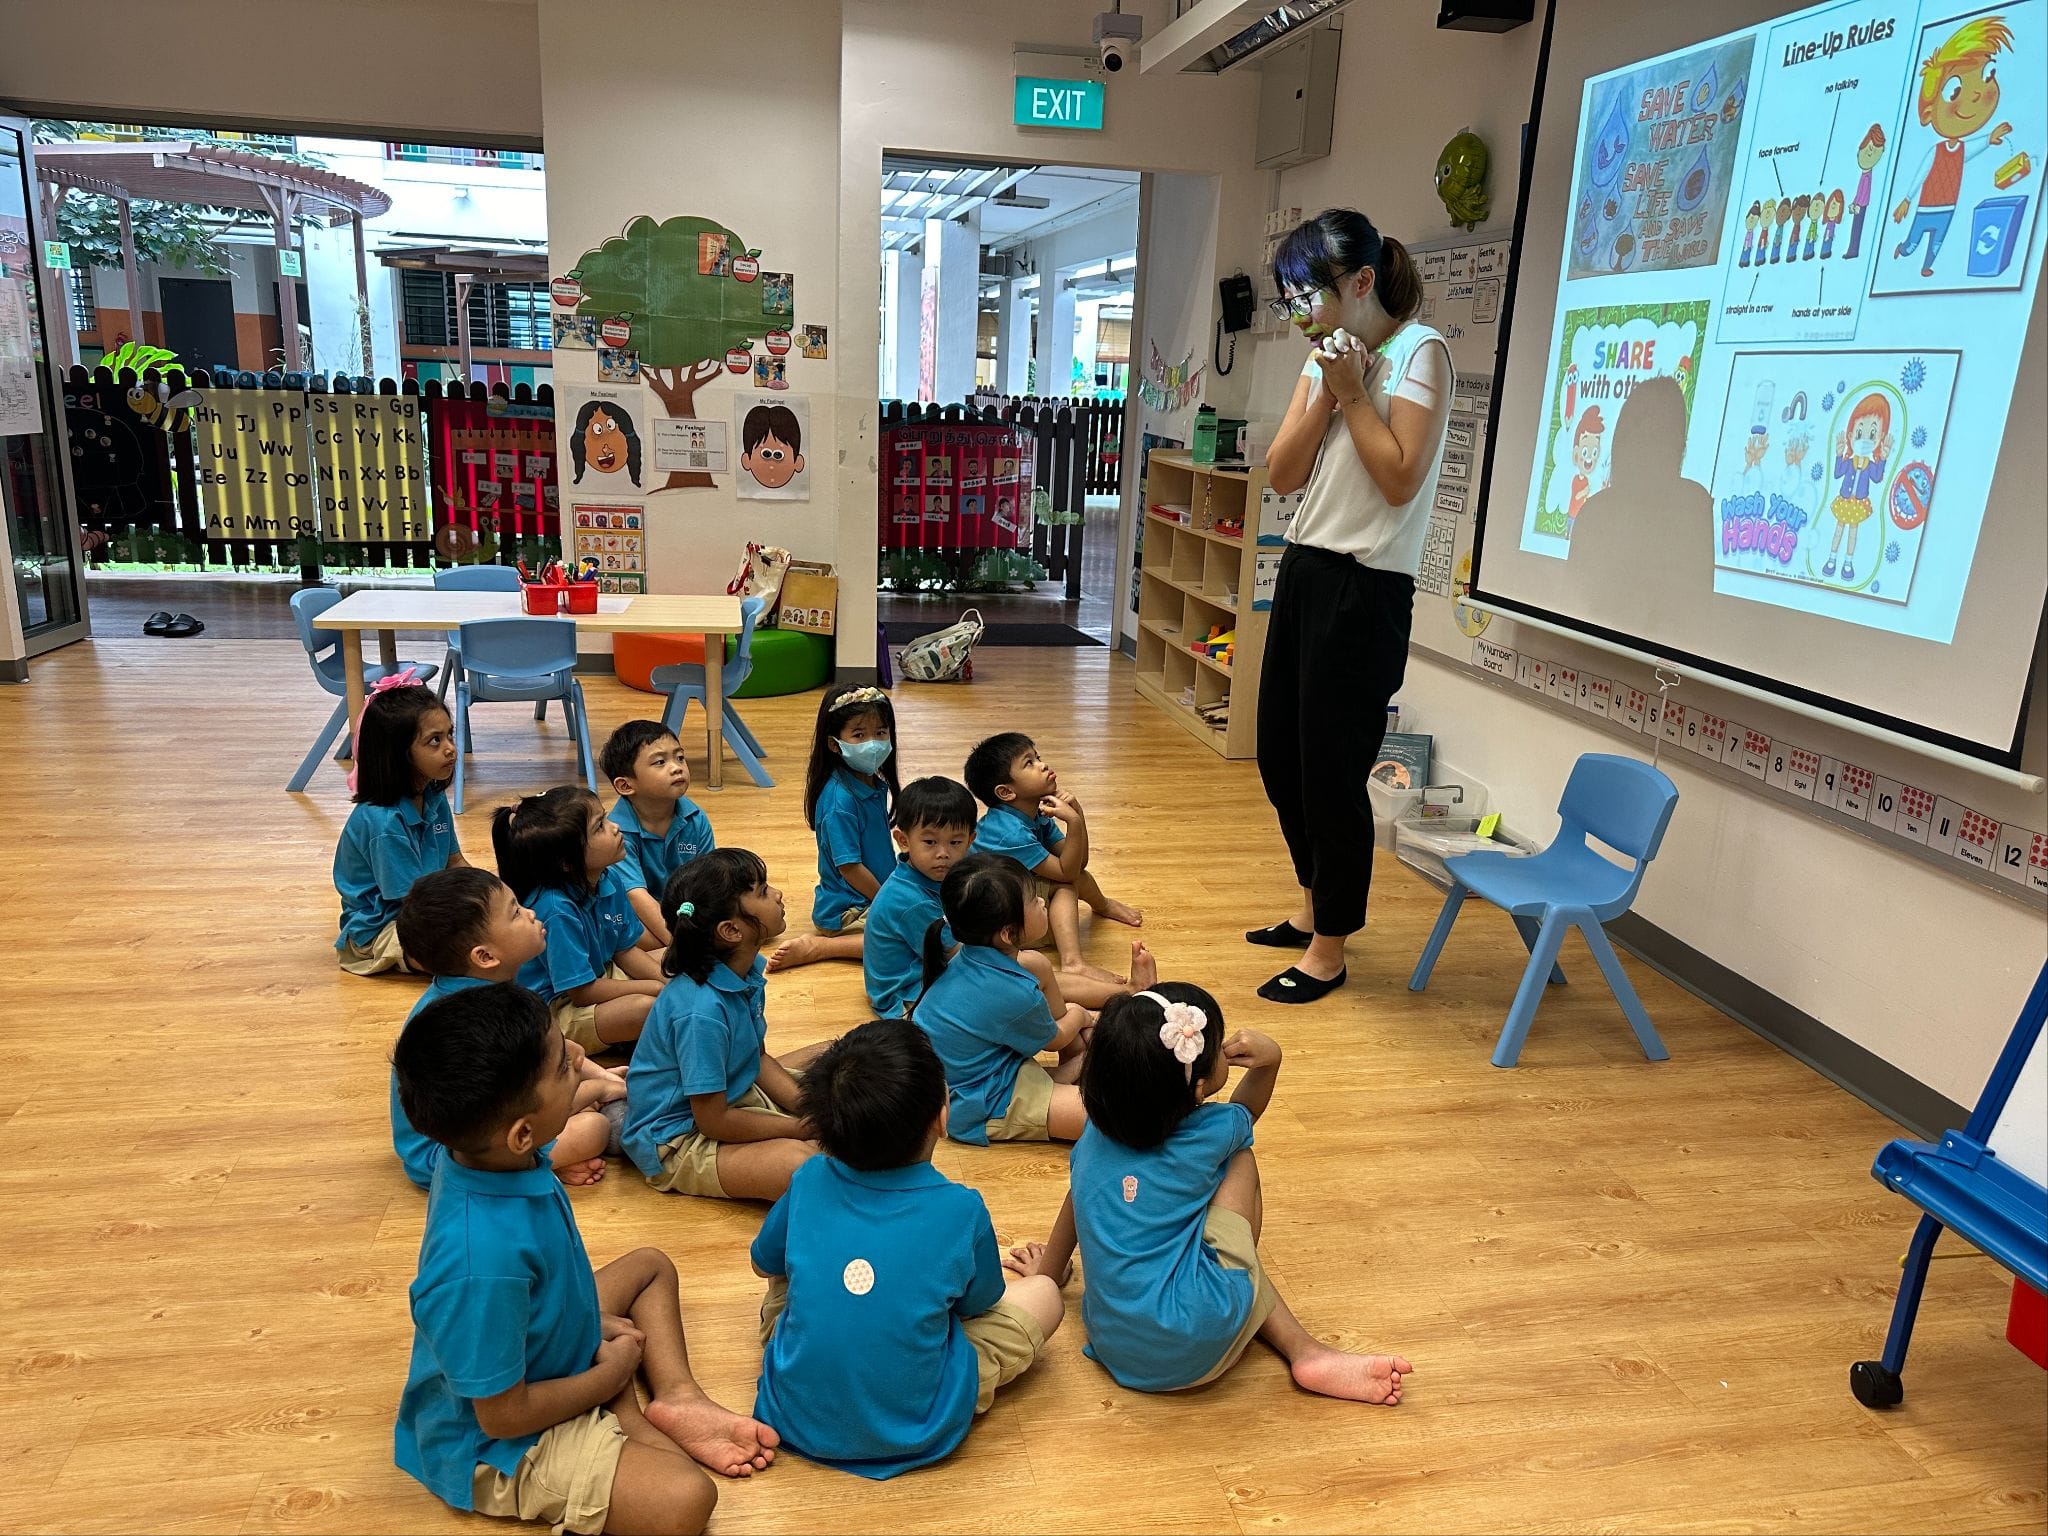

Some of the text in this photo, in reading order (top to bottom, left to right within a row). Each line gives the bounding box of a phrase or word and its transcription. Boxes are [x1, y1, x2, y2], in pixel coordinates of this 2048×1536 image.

[1783, 18, 1895, 67] Line-Up Rules
[1825, 78, 1859, 94] no talking
[1032, 87, 1086, 121] EXIT
[1638, 80, 1690, 122] SAVE
[1648, 112, 1718, 152] WATER
[1758, 142, 1800, 158] face forward
[1622, 159, 1669, 192] SAVE
[1634, 190, 1672, 219] LIFE
[1638, 211, 1708, 241] AND SAVE
[1452, 252, 1468, 261] Indoor
[1642, 239, 1672, 263] THE
[1726, 305, 1748, 316] straight
[1749, 305, 1754, 313] in
[1760, 305, 1773, 313] row
[1791, 307, 1852, 319] hands at your side
[1593, 340, 1656, 370] SHARE
[1466, 379, 1483, 393] today
[1580, 374, 1610, 399] with
[196, 407, 222, 424] Hh
[273, 402, 301, 422] Pp
[314, 399, 414, 419] Ss Rr Gg
[315, 428, 416, 447] Cc Yy Kk
[211, 440, 293, 460] Uu Ww
[203, 469, 308, 487] Ee Zz Oo
[320, 465, 420, 481] Nn Xx Bb
[1447, 464, 1460, 475] Friday
[325, 497, 417, 511] Dd Vv Ii
[1440, 496, 1461, 510] Saturday
[1721, 491, 1807, 532] Wash Your
[209, 514, 316, 534] Aa Mm Qq
[363, 522, 384, 537] Tt
[402, 522, 423, 537] Ff
[1722, 517, 1798, 565] Hands
[1477, 641, 1512, 662] My Number
[1483, 658, 1503, 673] Board
[1522, 666, 1525, 678] 1
[1550, 674, 1556, 686] 2
[1580, 684, 1587, 697] 3
[1615, 694, 1622, 709] 4
[1650, 708, 1657, 723] 5
[1688, 722, 1696, 737] 6
[1730, 736, 1738, 753] 7
[1746, 759, 1761, 771] Seven
[1774, 757, 1783, 773] 8
[1794, 779, 1807, 790] Eight
[1825, 773, 1834, 791] 9
[1845, 799, 1858, 810] Nine
[1877, 793, 1893, 813] 10
[1907, 823, 1917, 834] Ten
[1939, 817, 1950, 837] 11
[1960, 848, 1983, 865] Eleven
[2004, 844, 2022, 868] 12
